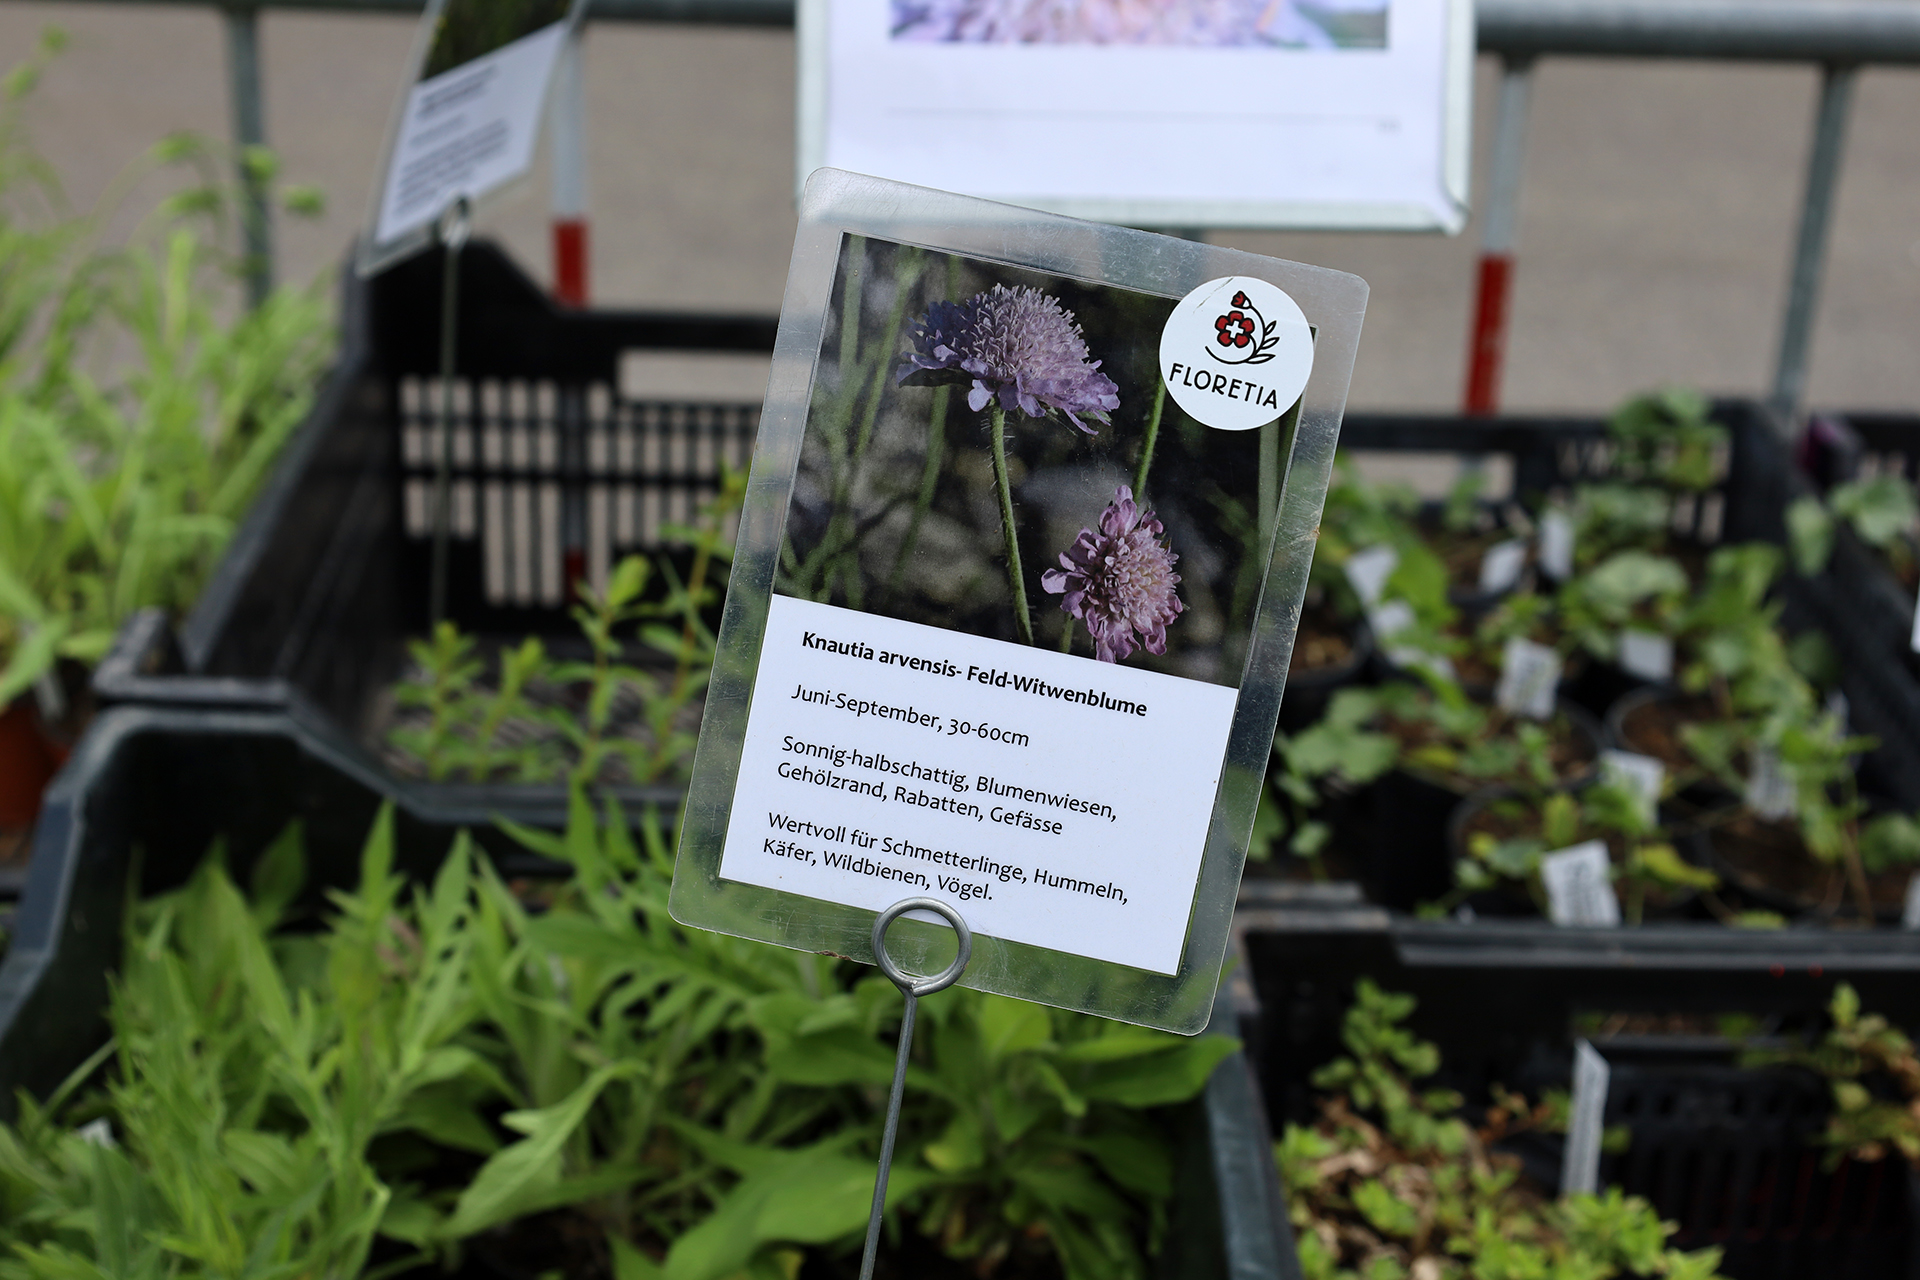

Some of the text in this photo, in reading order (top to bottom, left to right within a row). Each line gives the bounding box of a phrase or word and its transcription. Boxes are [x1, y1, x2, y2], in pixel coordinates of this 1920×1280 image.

[1169, 362, 1278, 410] FLORETIA
[803, 632, 1148, 717] Knautia arvensis- Feld-Witwenblume
[791, 685, 1029, 746] Juni-September, 30-60cm
[778, 763, 1062, 835] Gehölzrand, Rabatten, Gefässe
[782, 736, 1116, 822] Sonnig-halbschattig, Blumenwiesen,
[764, 839, 992, 900] Käfer, Wildbienen, Vögel.
[769, 813, 1127, 905] Wertvoll für Schmetterlinge, Hummeln,
